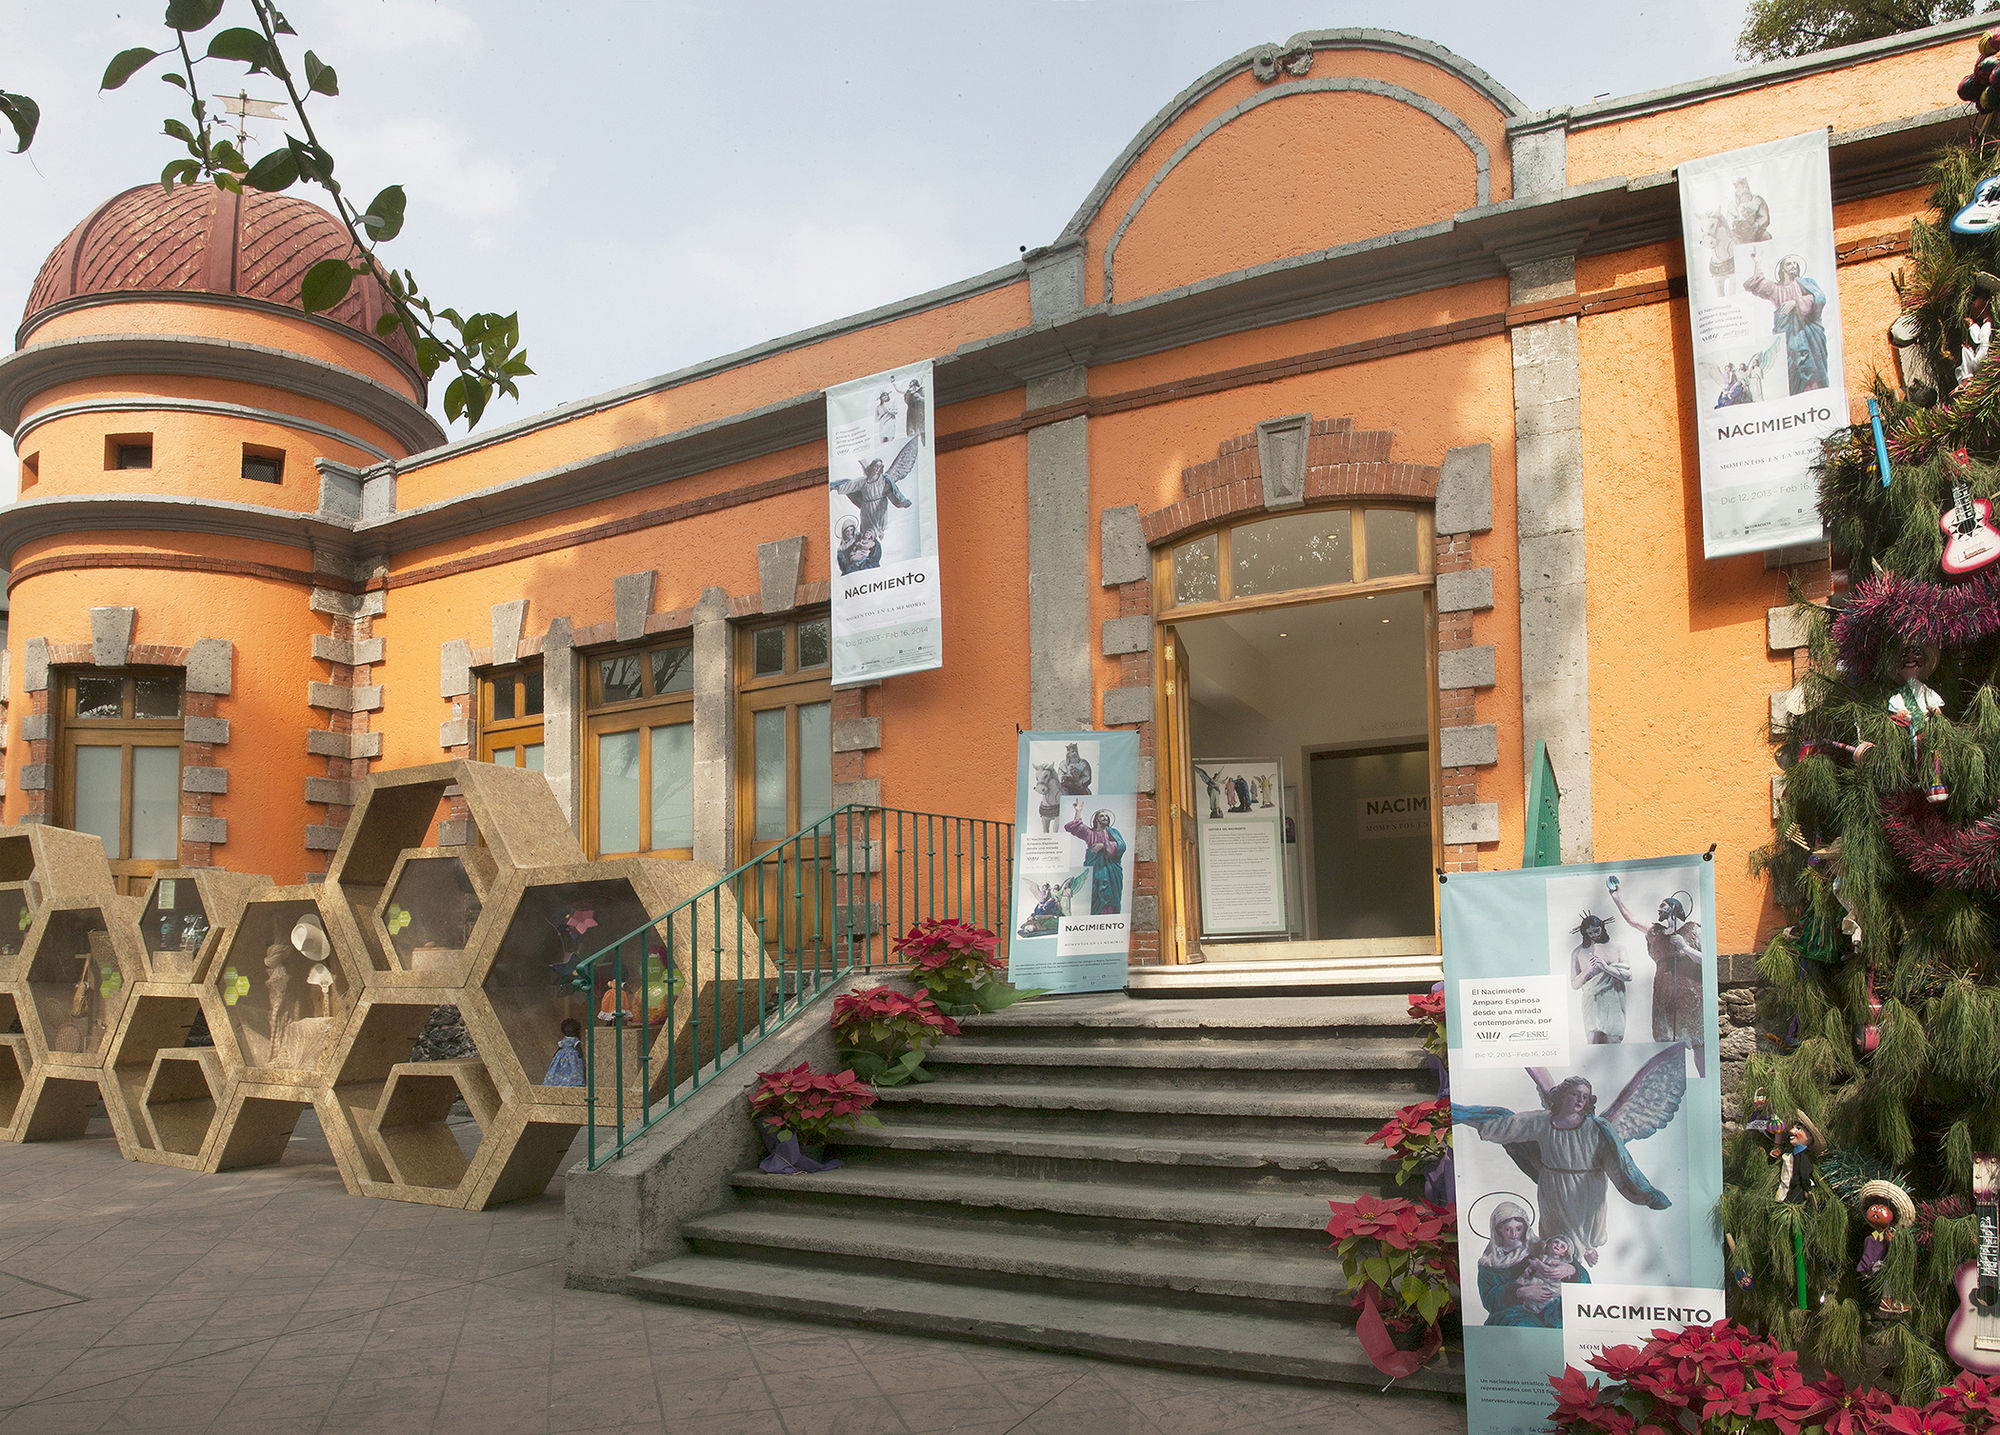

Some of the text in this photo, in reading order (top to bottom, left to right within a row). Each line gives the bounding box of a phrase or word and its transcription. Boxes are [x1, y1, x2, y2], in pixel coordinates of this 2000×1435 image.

[1718, 407, 1831, 440] NACIMIENTO
[1720, 458, 1765, 471] MOMENTOS
[1721, 496, 1736, 505] Dic
[1738, 493, 1750, 502] 12,
[1751, 490, 1772, 499] 2013
[1780, 484, 1797, 493] Feb
[845, 572, 925, 599] NACIMIENTO
[897, 601, 926, 610] MEMORIA
[911, 626, 928, 635] 2014
[1366, 797, 1428, 815] NACIM
[1065, 922, 1125, 931] NACIMIENTO
[1473, 1018, 1536, 1026] contemporánea,
[1577, 1304, 1712, 1323] NACIMIENTO
